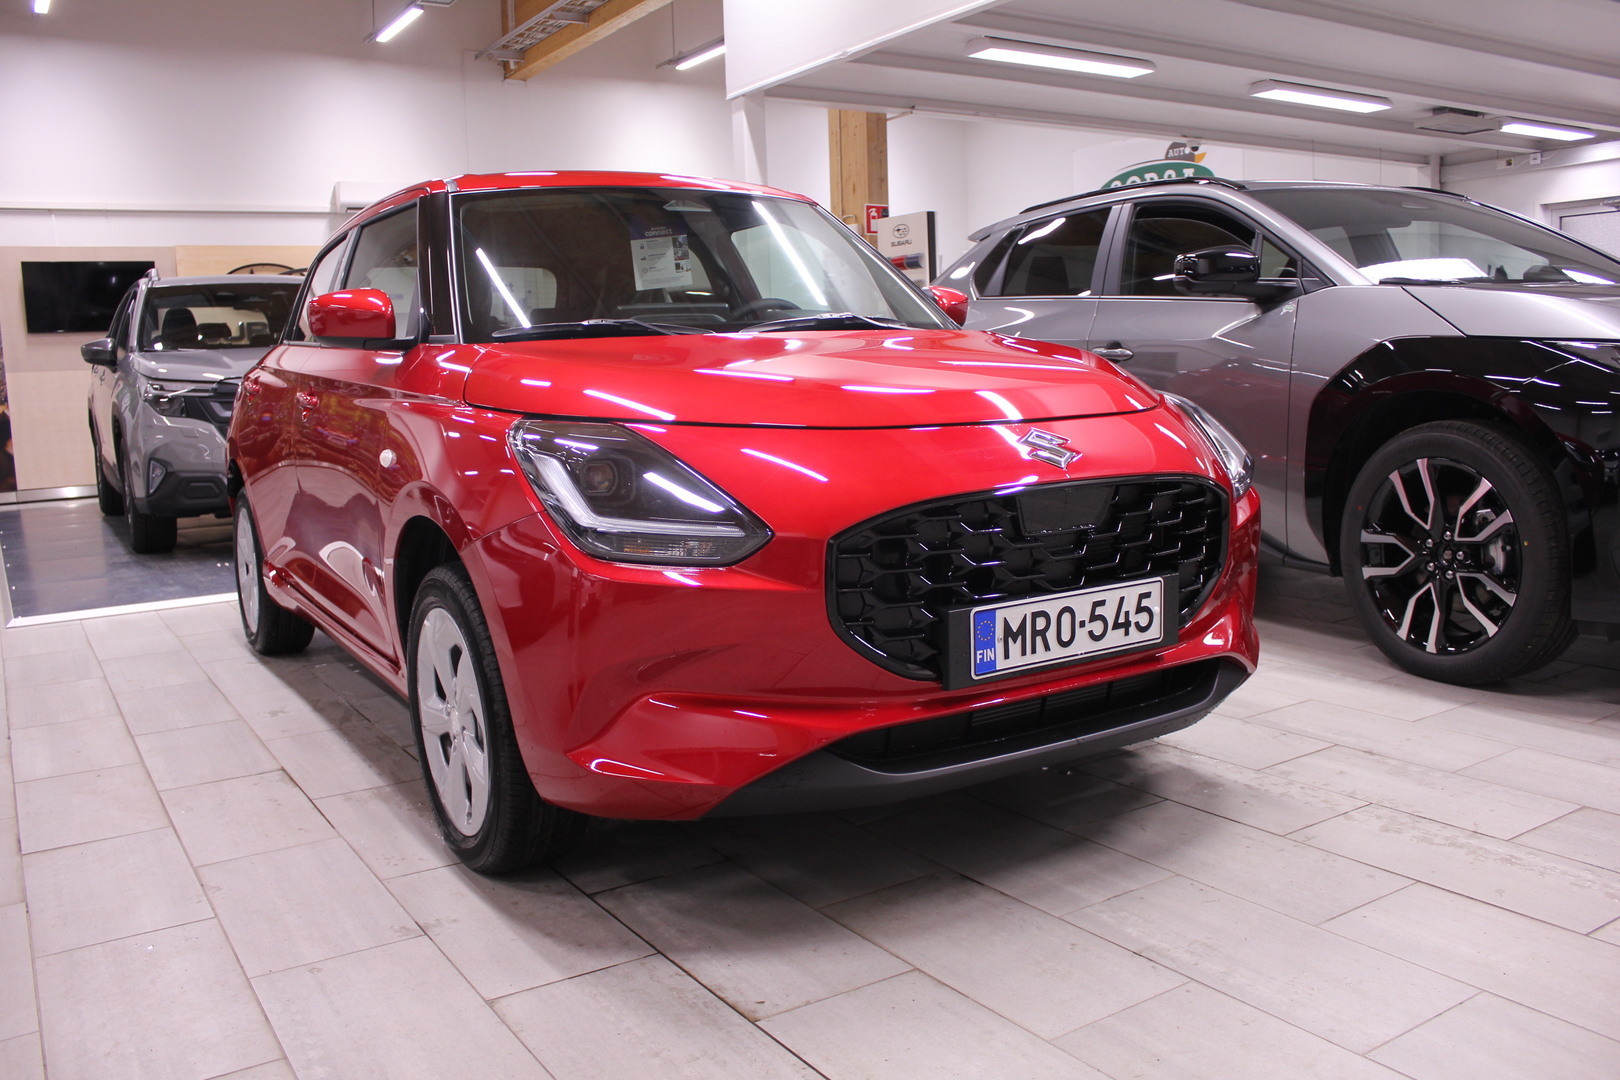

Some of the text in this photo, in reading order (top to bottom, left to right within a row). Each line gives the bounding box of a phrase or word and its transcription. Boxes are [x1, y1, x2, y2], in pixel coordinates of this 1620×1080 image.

[891, 239, 912, 247] SUBARU
[1003, 591, 1155, 660] MRO-545
[976, 647, 995, 664] FIN
